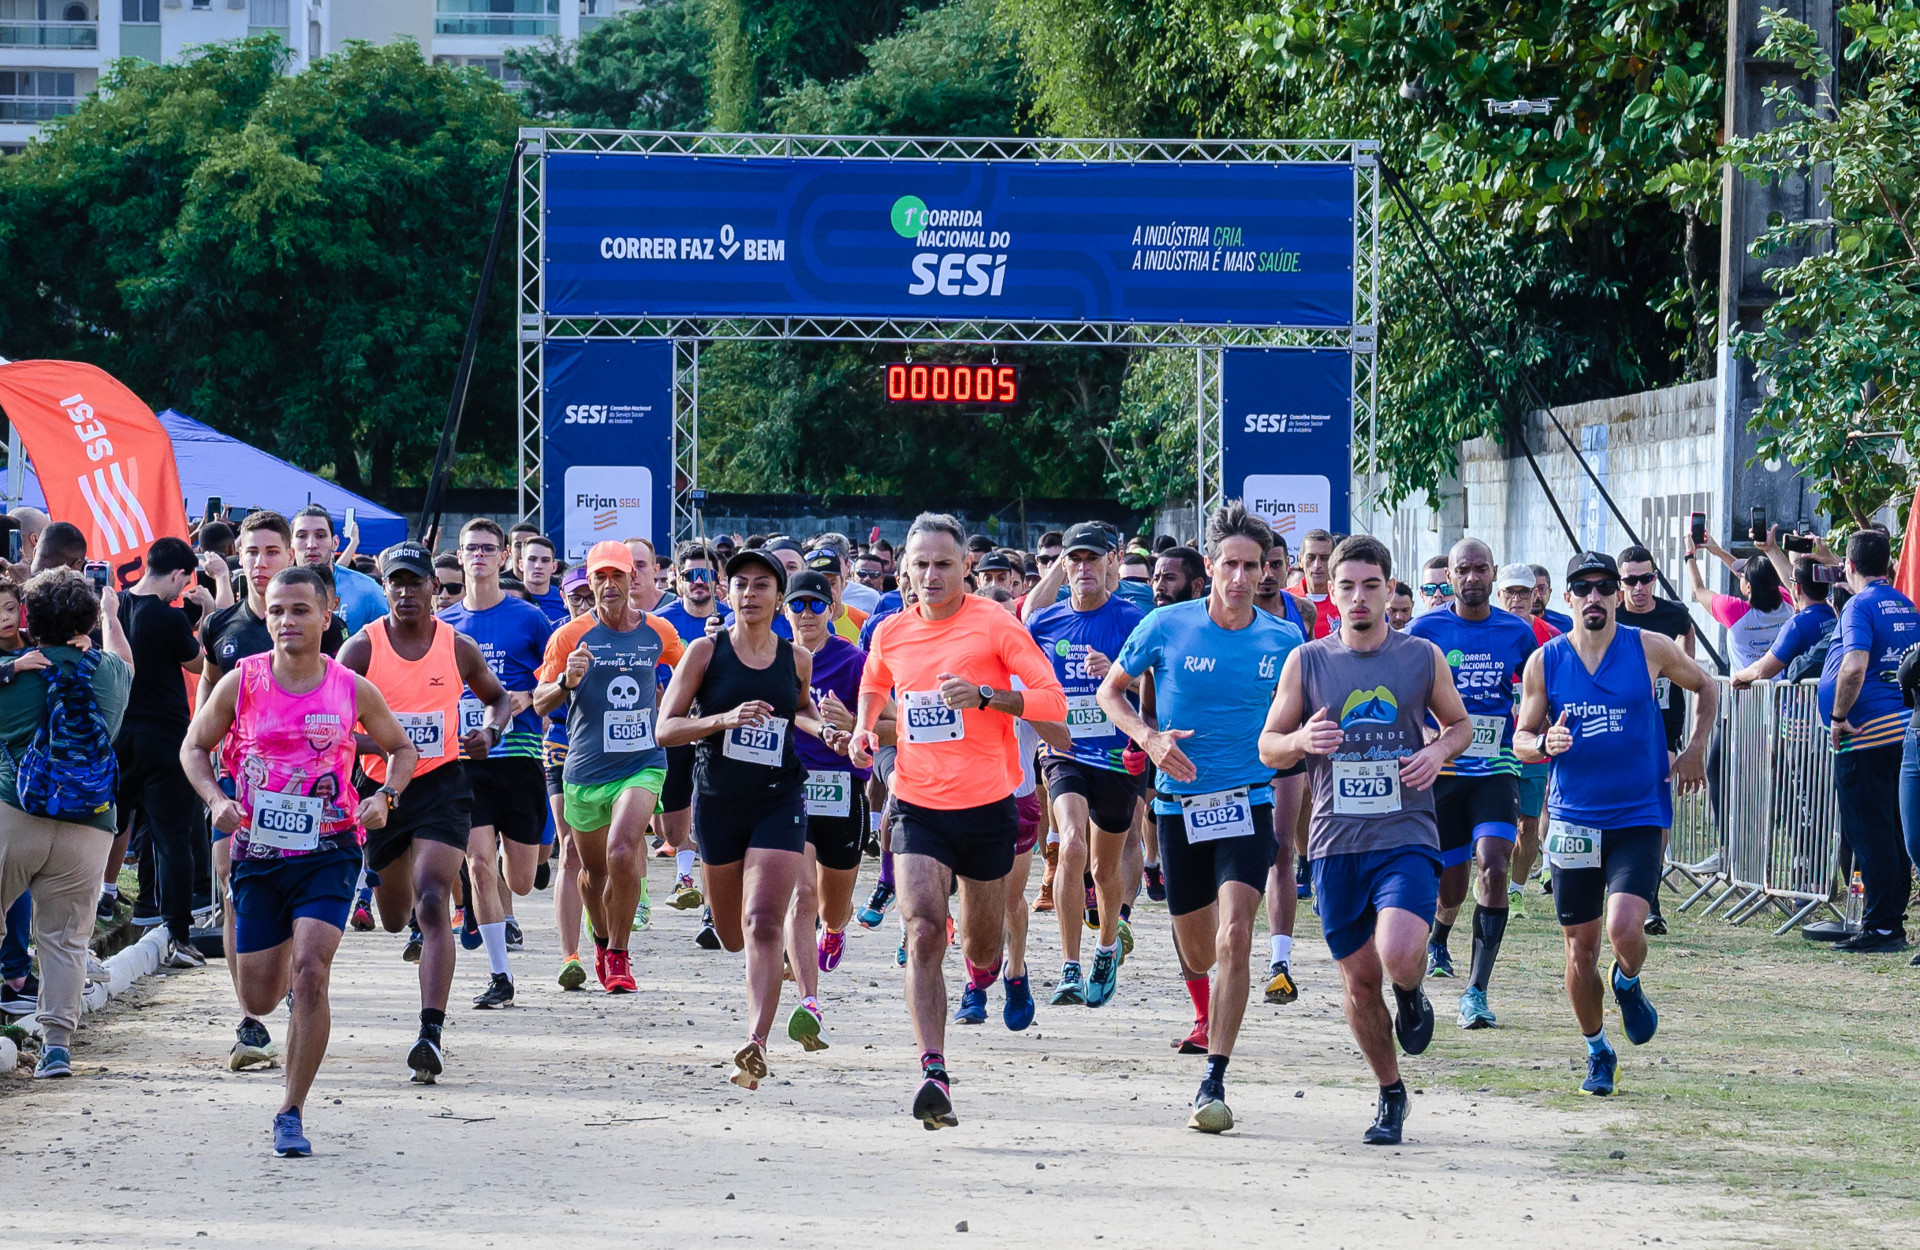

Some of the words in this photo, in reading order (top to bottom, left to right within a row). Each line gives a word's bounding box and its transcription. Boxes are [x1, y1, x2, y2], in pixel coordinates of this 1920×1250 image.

[920, 209, 982, 227] CORRIDA
[600, 237, 676, 259] CORRER
[680, 238, 714, 260] FAZ
[720, 224, 734, 246] O
[744, 239, 785, 261] BEM
[916, 230, 986, 248] NACIONAL
[989, 231, 1010, 248] DO
[1132, 225, 1141, 246] A
[1144, 221, 1209, 246] INDÚSTRIA
[1213, 226, 1245, 247] CRIA.
[1132, 250, 1141, 270] A
[1144, 246, 1209, 271] INDÚSTRIA
[1212, 246, 1222, 271] É
[1223, 251, 1256, 272] MAIS
[1257, 248, 1301, 272] SAÚDE.
[60, 393, 114, 462] SESI
[576, 494, 617, 511] Firjan
[619, 498, 640, 508] SESI
[1255, 499, 1296, 516] Firjan
[1298, 503, 1319, 513] SESI
[1184, 655, 1216, 673] RUN
[1459, 662, 1493, 670] NACIONAL
[1494, 661, 1504, 669] DO
[1460, 653, 1491, 661] CORRIDA
[305, 714, 340, 724] CORRIDA
[910, 707, 950, 726] 5632
[1071, 709, 1102, 724] 1035
[1563, 701, 1607, 719] Firjan
[406, 727, 434, 743] 064
[613, 723, 642, 738] 5085
[740, 728, 771, 749] 5121
[1336, 731, 1404, 741] ESENDE
[1472, 729, 1493, 743] 002
[806, 785, 836, 800] 1122
[1344, 778, 1386, 796] 5276
[263, 810, 307, 832] 5086
[1195, 806, 1239, 826] 5082
